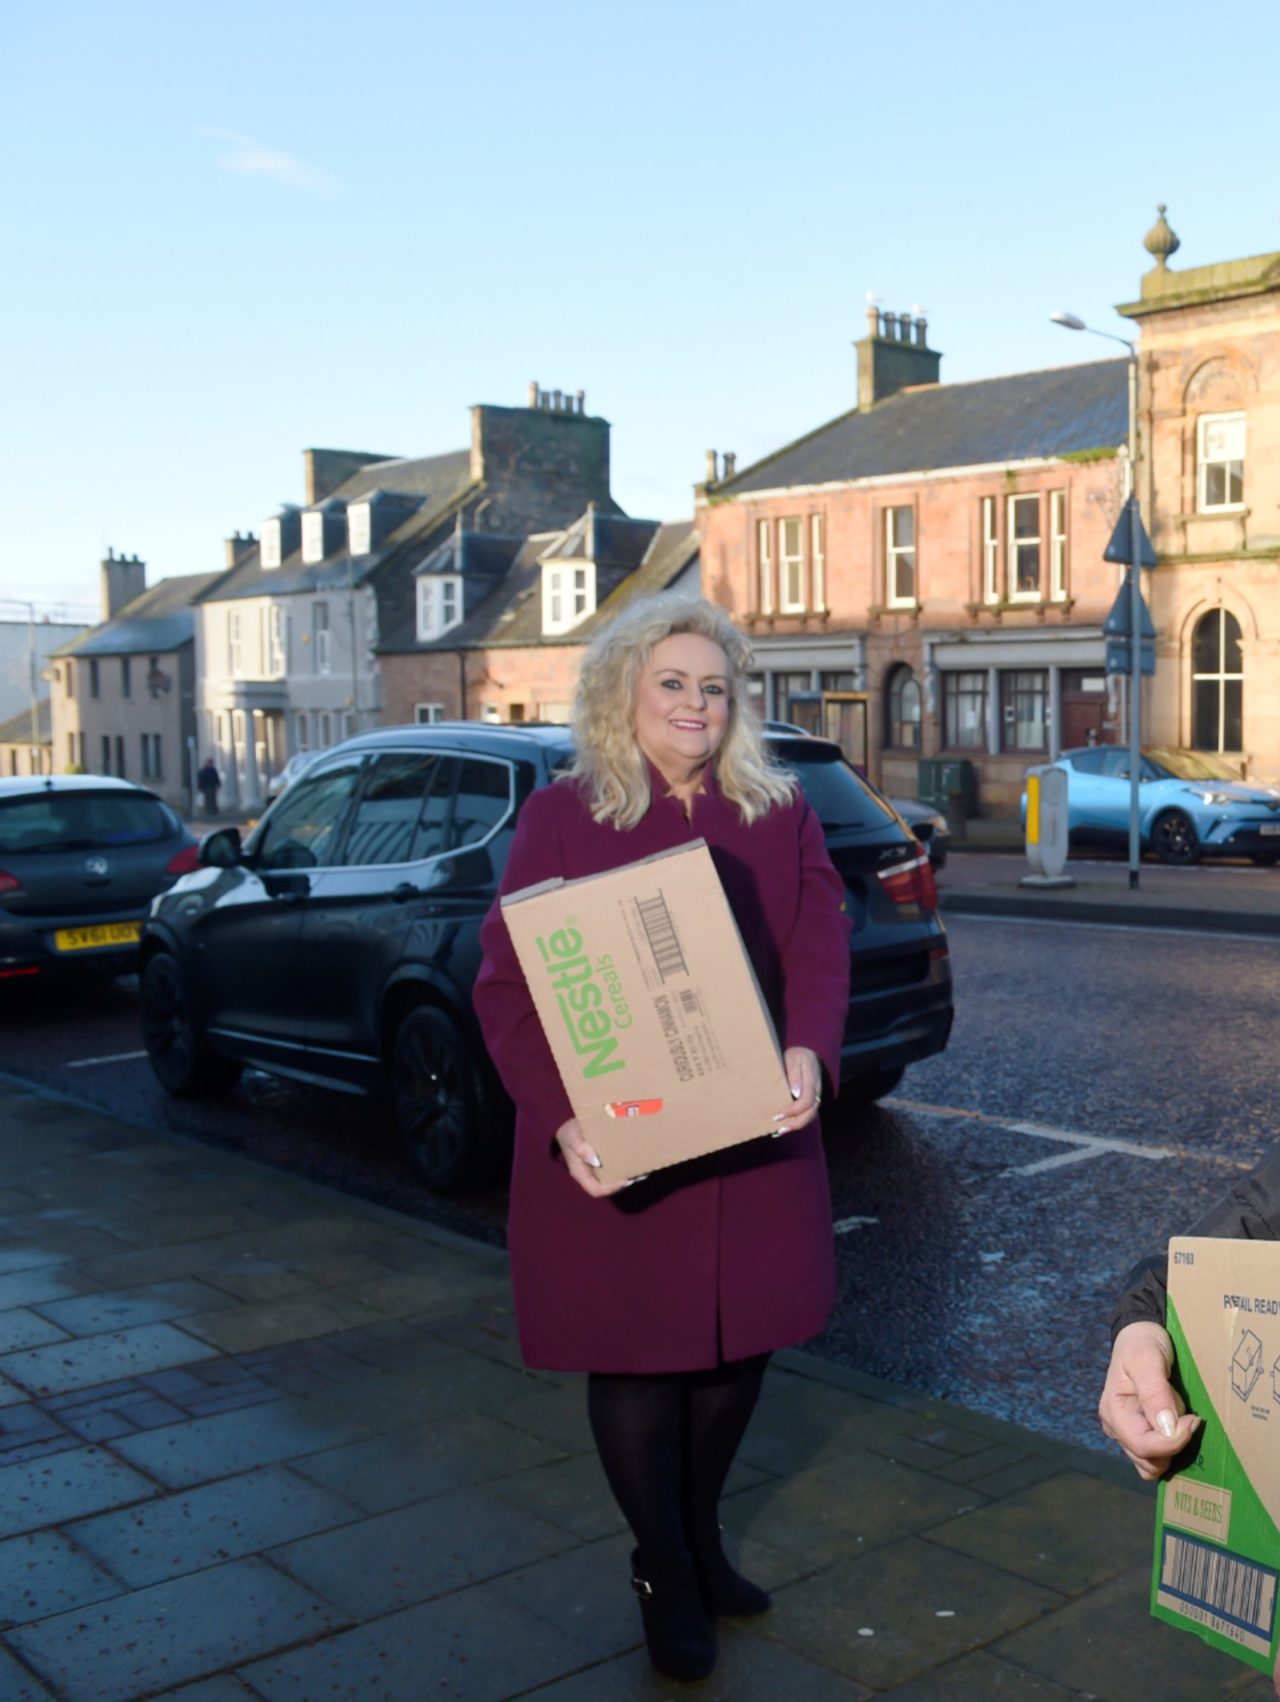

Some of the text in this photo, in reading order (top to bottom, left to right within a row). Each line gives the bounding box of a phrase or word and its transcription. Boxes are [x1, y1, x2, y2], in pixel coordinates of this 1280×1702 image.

[596, 953, 633, 1030] Cereals
[1173, 1252, 1194, 1265] 67163
[1174, 1490, 1223, 1524] NUTS & SEEDS
